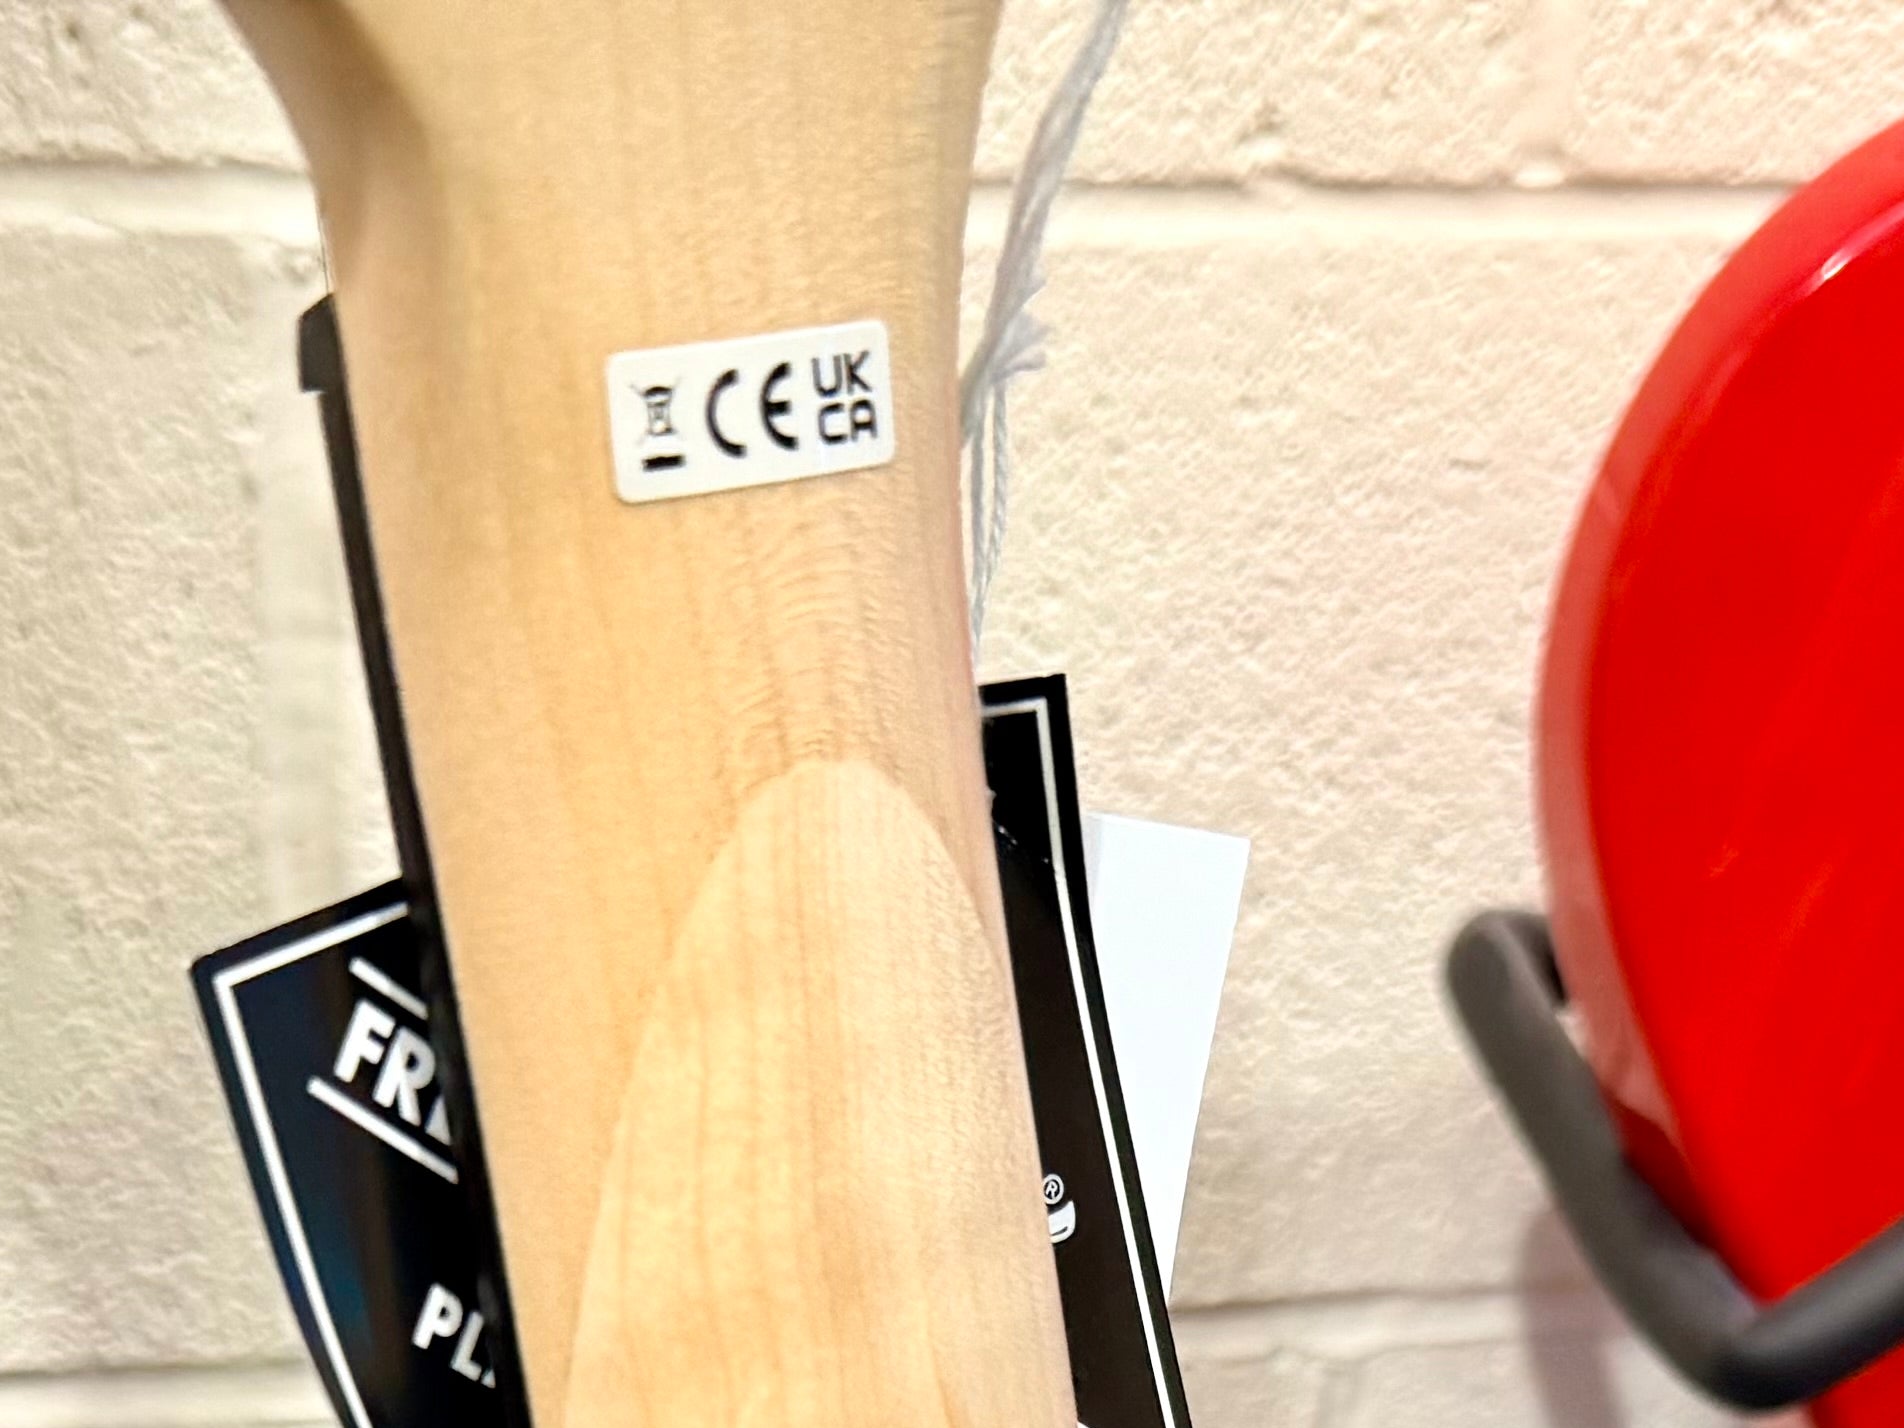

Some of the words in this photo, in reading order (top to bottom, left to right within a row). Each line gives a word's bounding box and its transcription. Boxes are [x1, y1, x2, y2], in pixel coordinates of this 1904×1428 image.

[811, 350, 872, 397] UK
[817, 399, 877, 445] CA
[412, 1282, 496, 1389] PL
